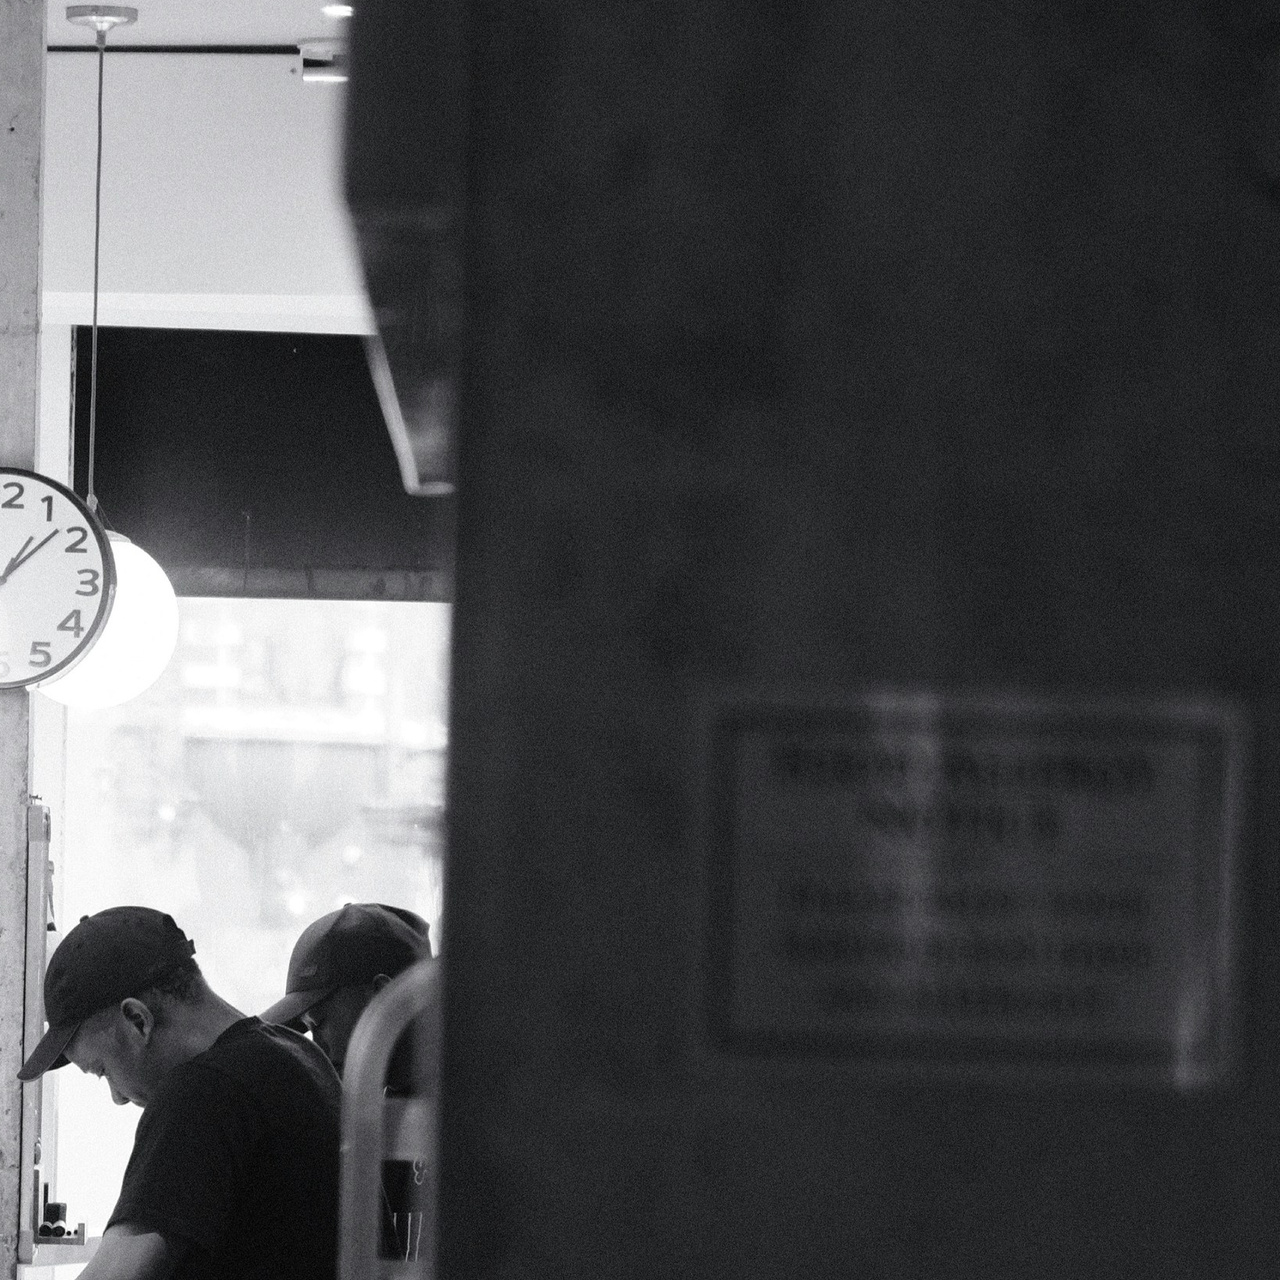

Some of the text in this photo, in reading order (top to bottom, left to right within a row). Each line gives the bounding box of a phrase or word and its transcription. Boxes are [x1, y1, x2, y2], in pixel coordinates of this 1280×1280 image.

[40, 495, 54, 522] 1
[64, 526, 88, 553] 2
[75, 568, 100, 597] 3
[56, 609, 84, 638] 4
[28, 641, 52, 668] 5
